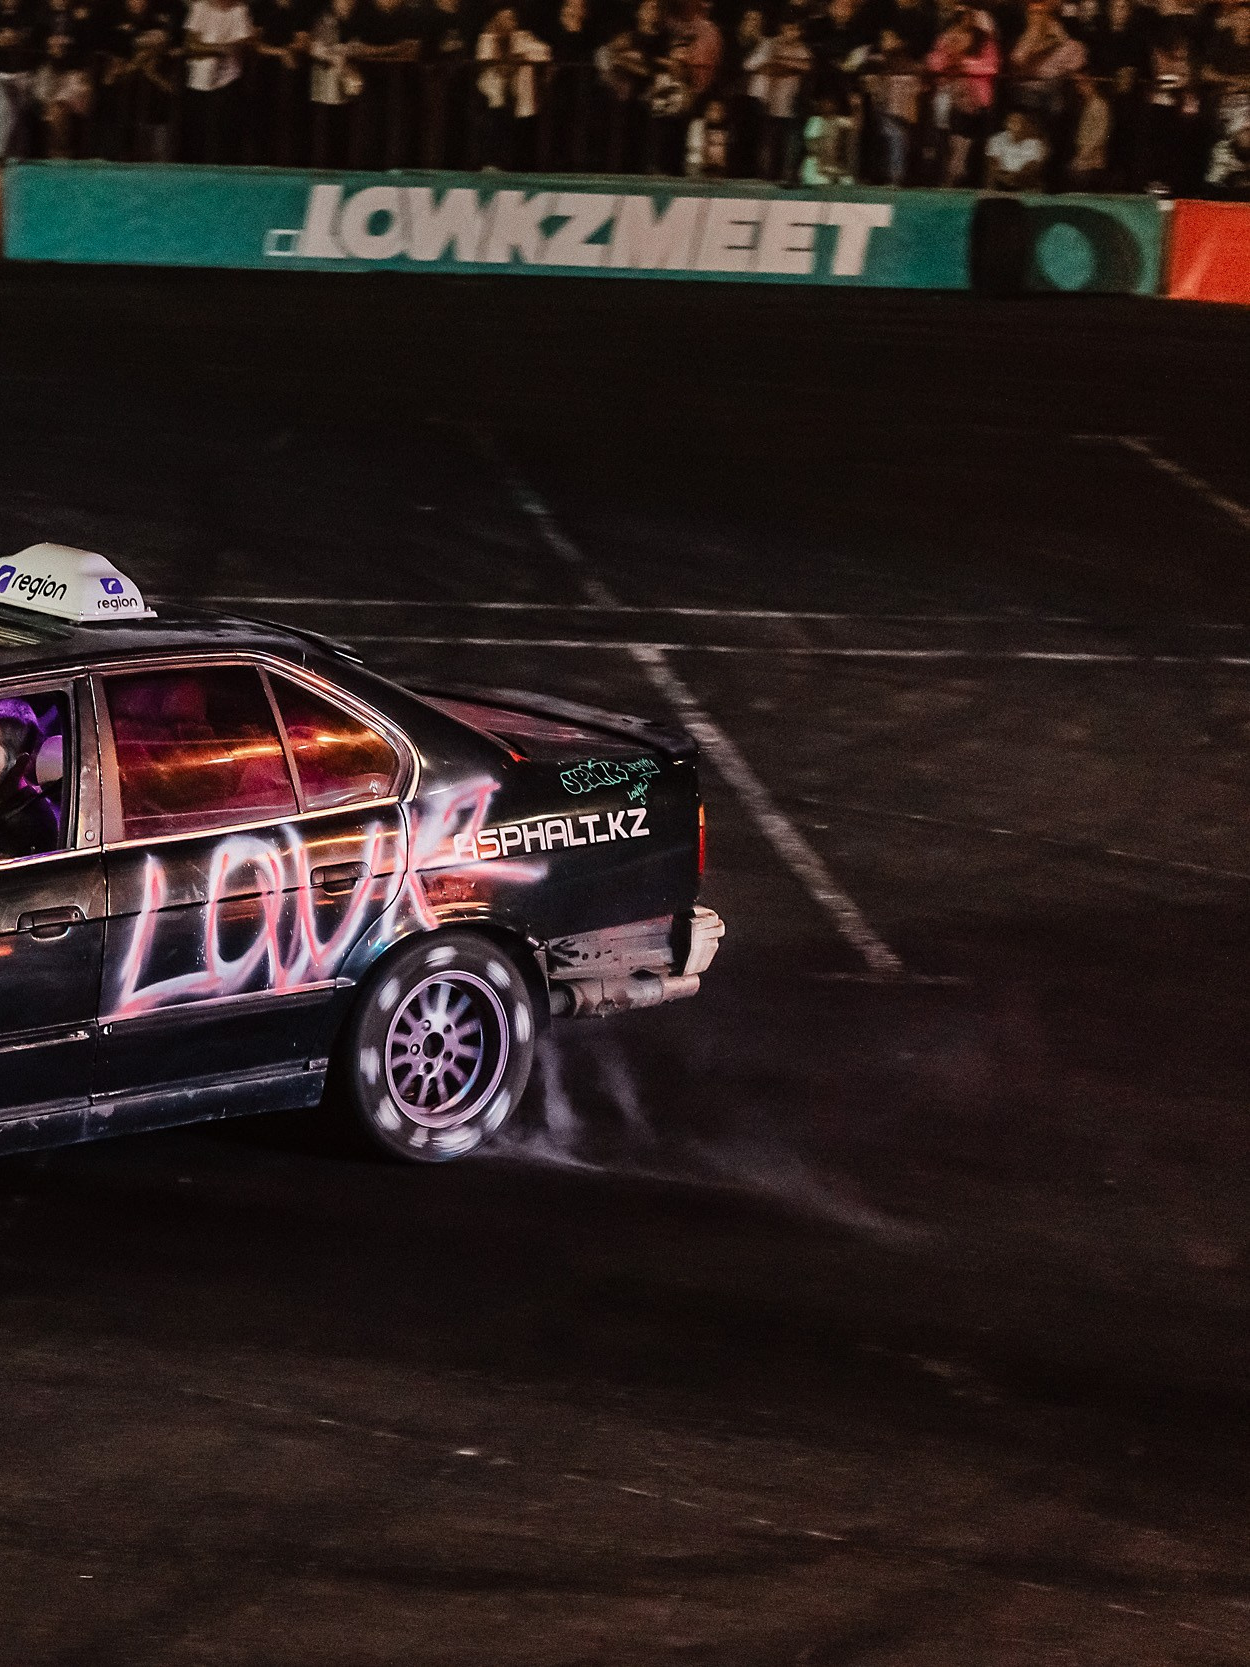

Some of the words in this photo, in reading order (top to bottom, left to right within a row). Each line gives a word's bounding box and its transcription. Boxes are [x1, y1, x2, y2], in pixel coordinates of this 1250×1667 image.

[261, 183, 894, 276] LOWKZMEET
[11, 573, 68, 601] region
[97, 596, 138, 612] region
